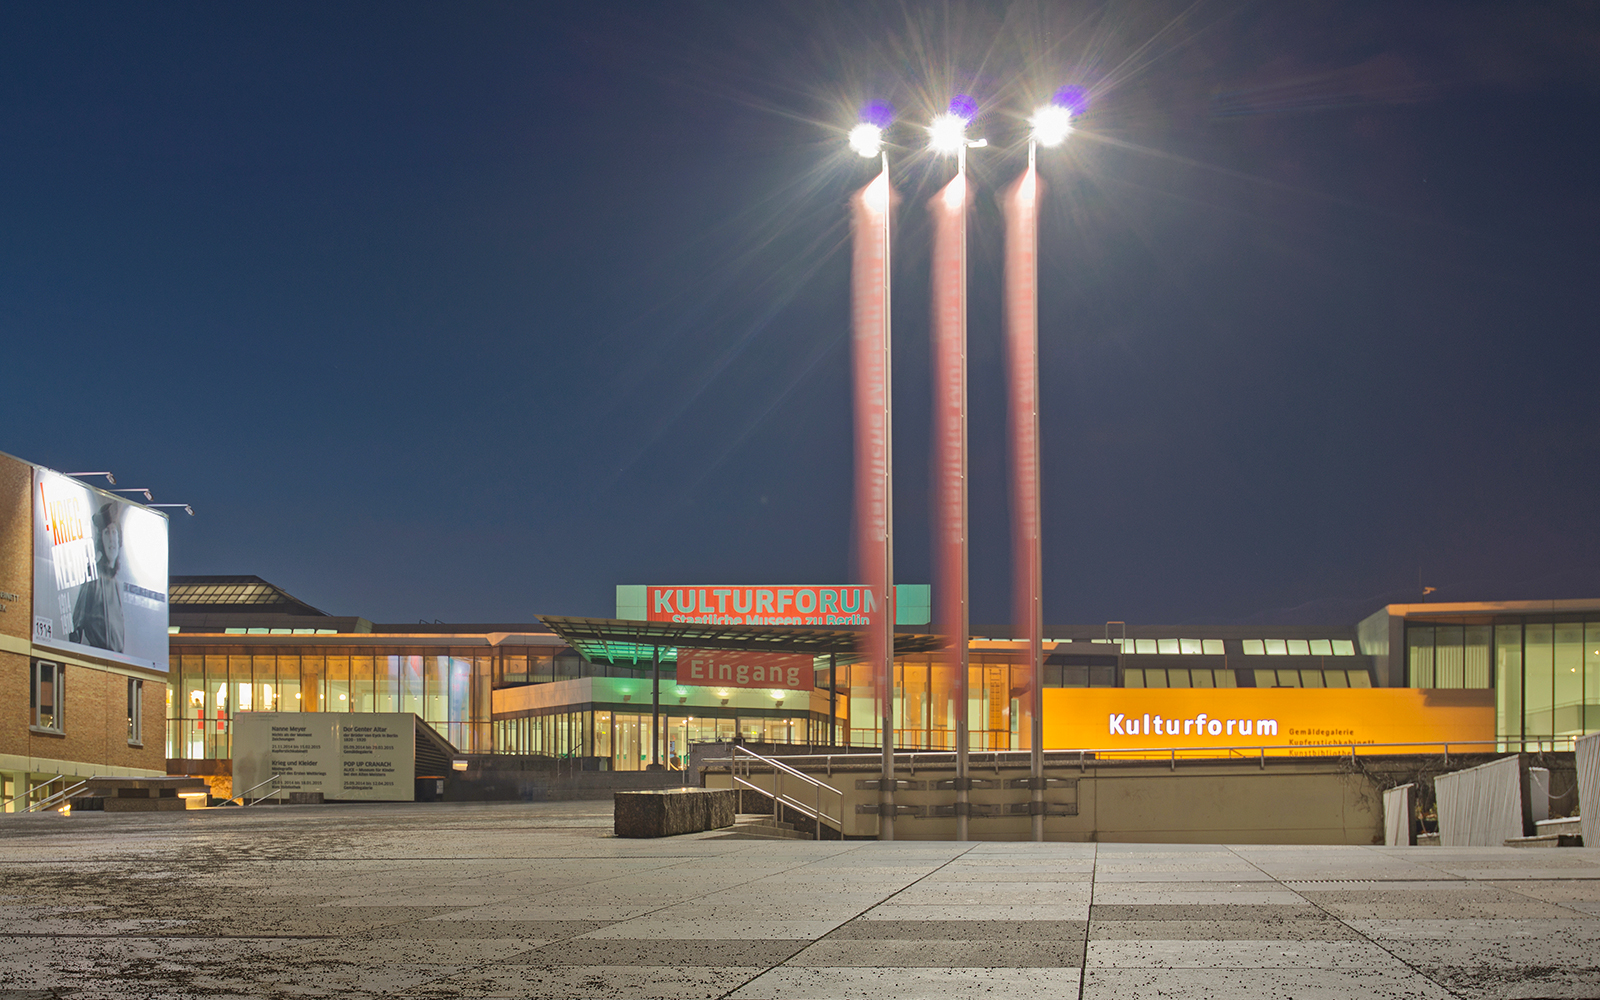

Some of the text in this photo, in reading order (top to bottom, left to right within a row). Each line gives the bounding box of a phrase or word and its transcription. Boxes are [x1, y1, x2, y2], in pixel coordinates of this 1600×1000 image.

[49, 497, 83, 546] KRIEG
[672, 614, 870, 625] Staatliche Museen zu Berlin
[36, 622, 52, 638] 1914
[691, 659, 800, 686] Eingang
[1109, 713, 1278, 736] Kulturforum
[1289, 728, 1354, 736] Gemäldegalerie
